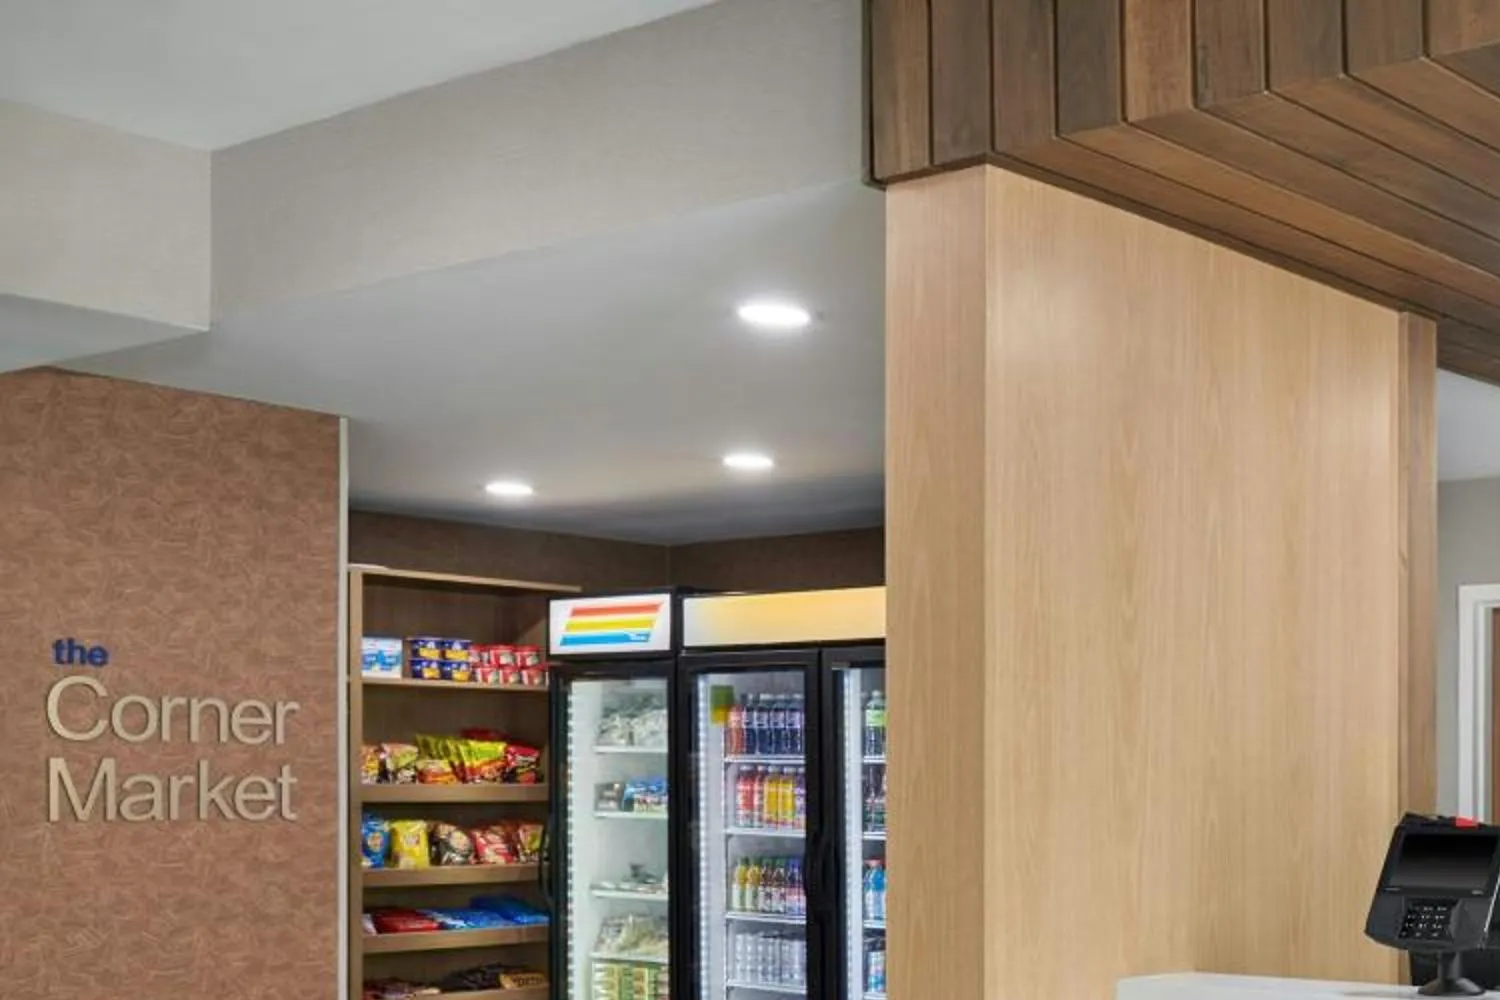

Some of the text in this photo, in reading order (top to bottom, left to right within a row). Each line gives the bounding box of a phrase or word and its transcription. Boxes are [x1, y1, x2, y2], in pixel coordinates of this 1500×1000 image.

[53, 637, 109, 667] the
[47, 675, 300, 745] Corner
[48, 756, 298, 822] Market
